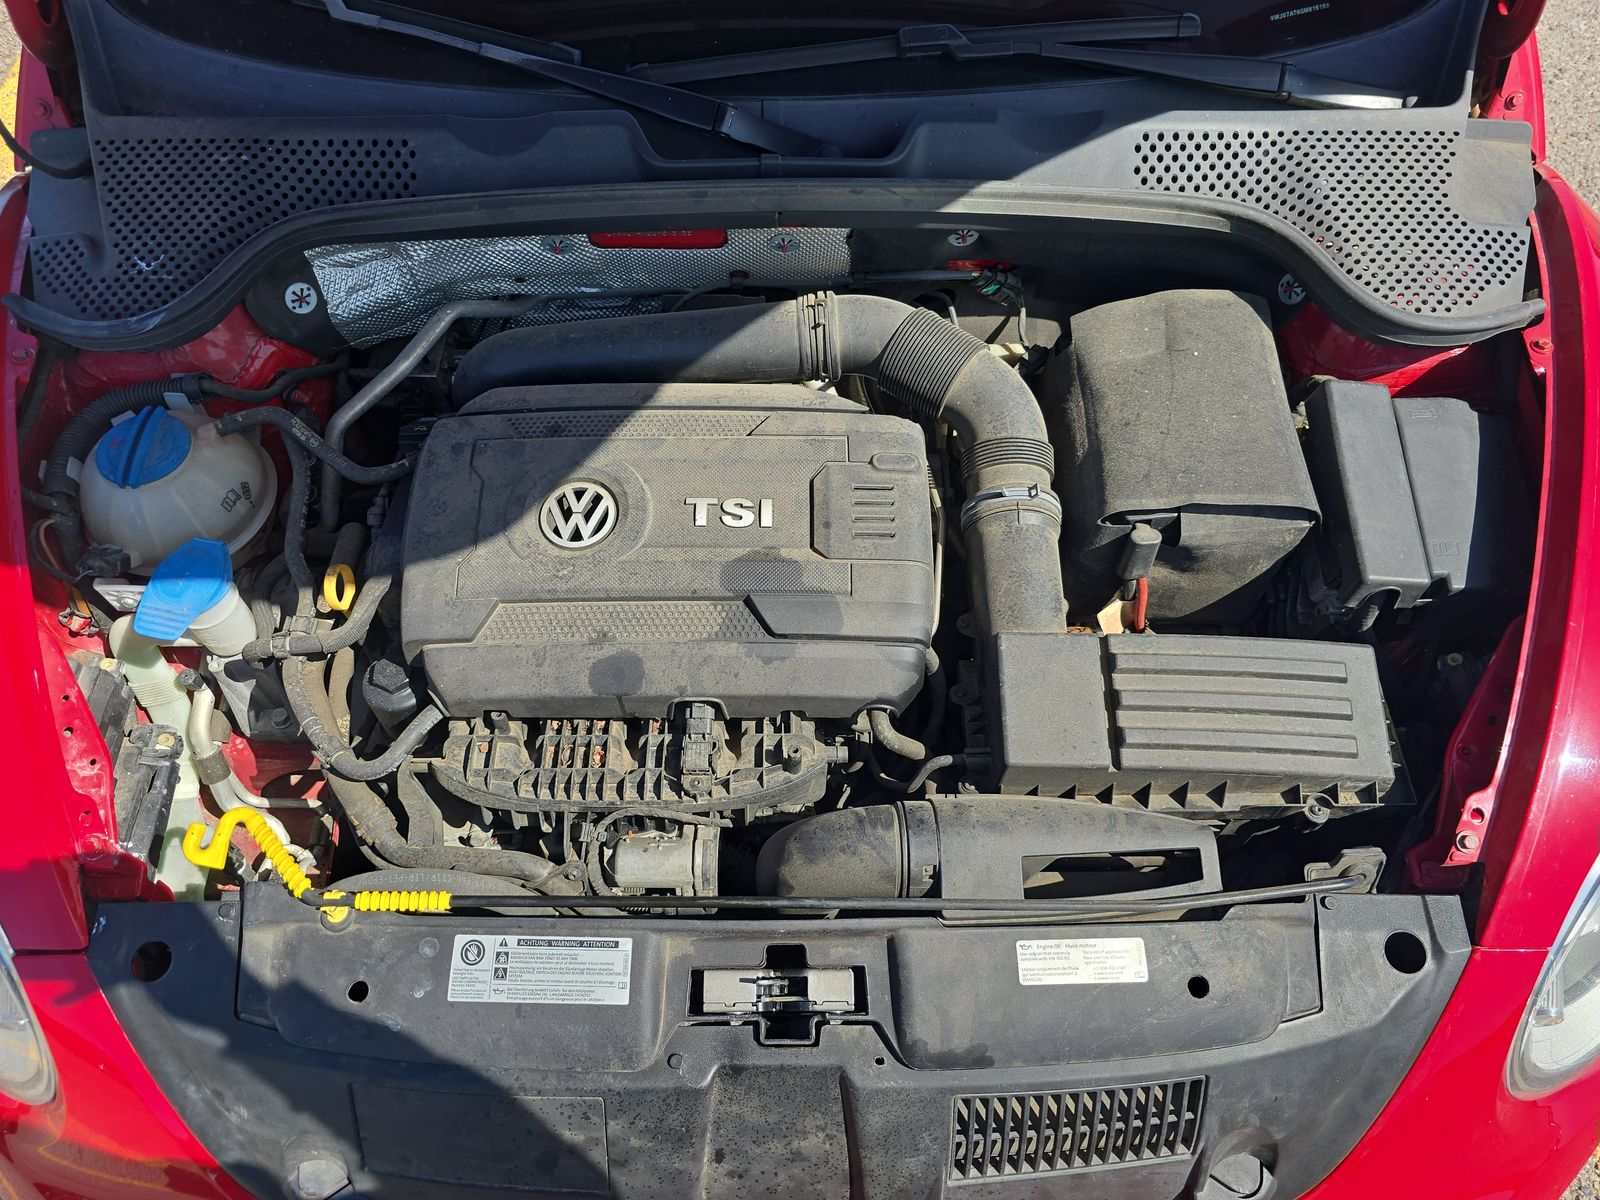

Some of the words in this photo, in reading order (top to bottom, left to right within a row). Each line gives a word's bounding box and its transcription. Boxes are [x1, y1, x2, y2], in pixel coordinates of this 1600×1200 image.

[685, 498, 773, 528] TSI
[519, 939, 548, 947] ACHTUNG
[552, 939, 580, 947] WARNING
[583, 940, 615, 948] ATTENTION
